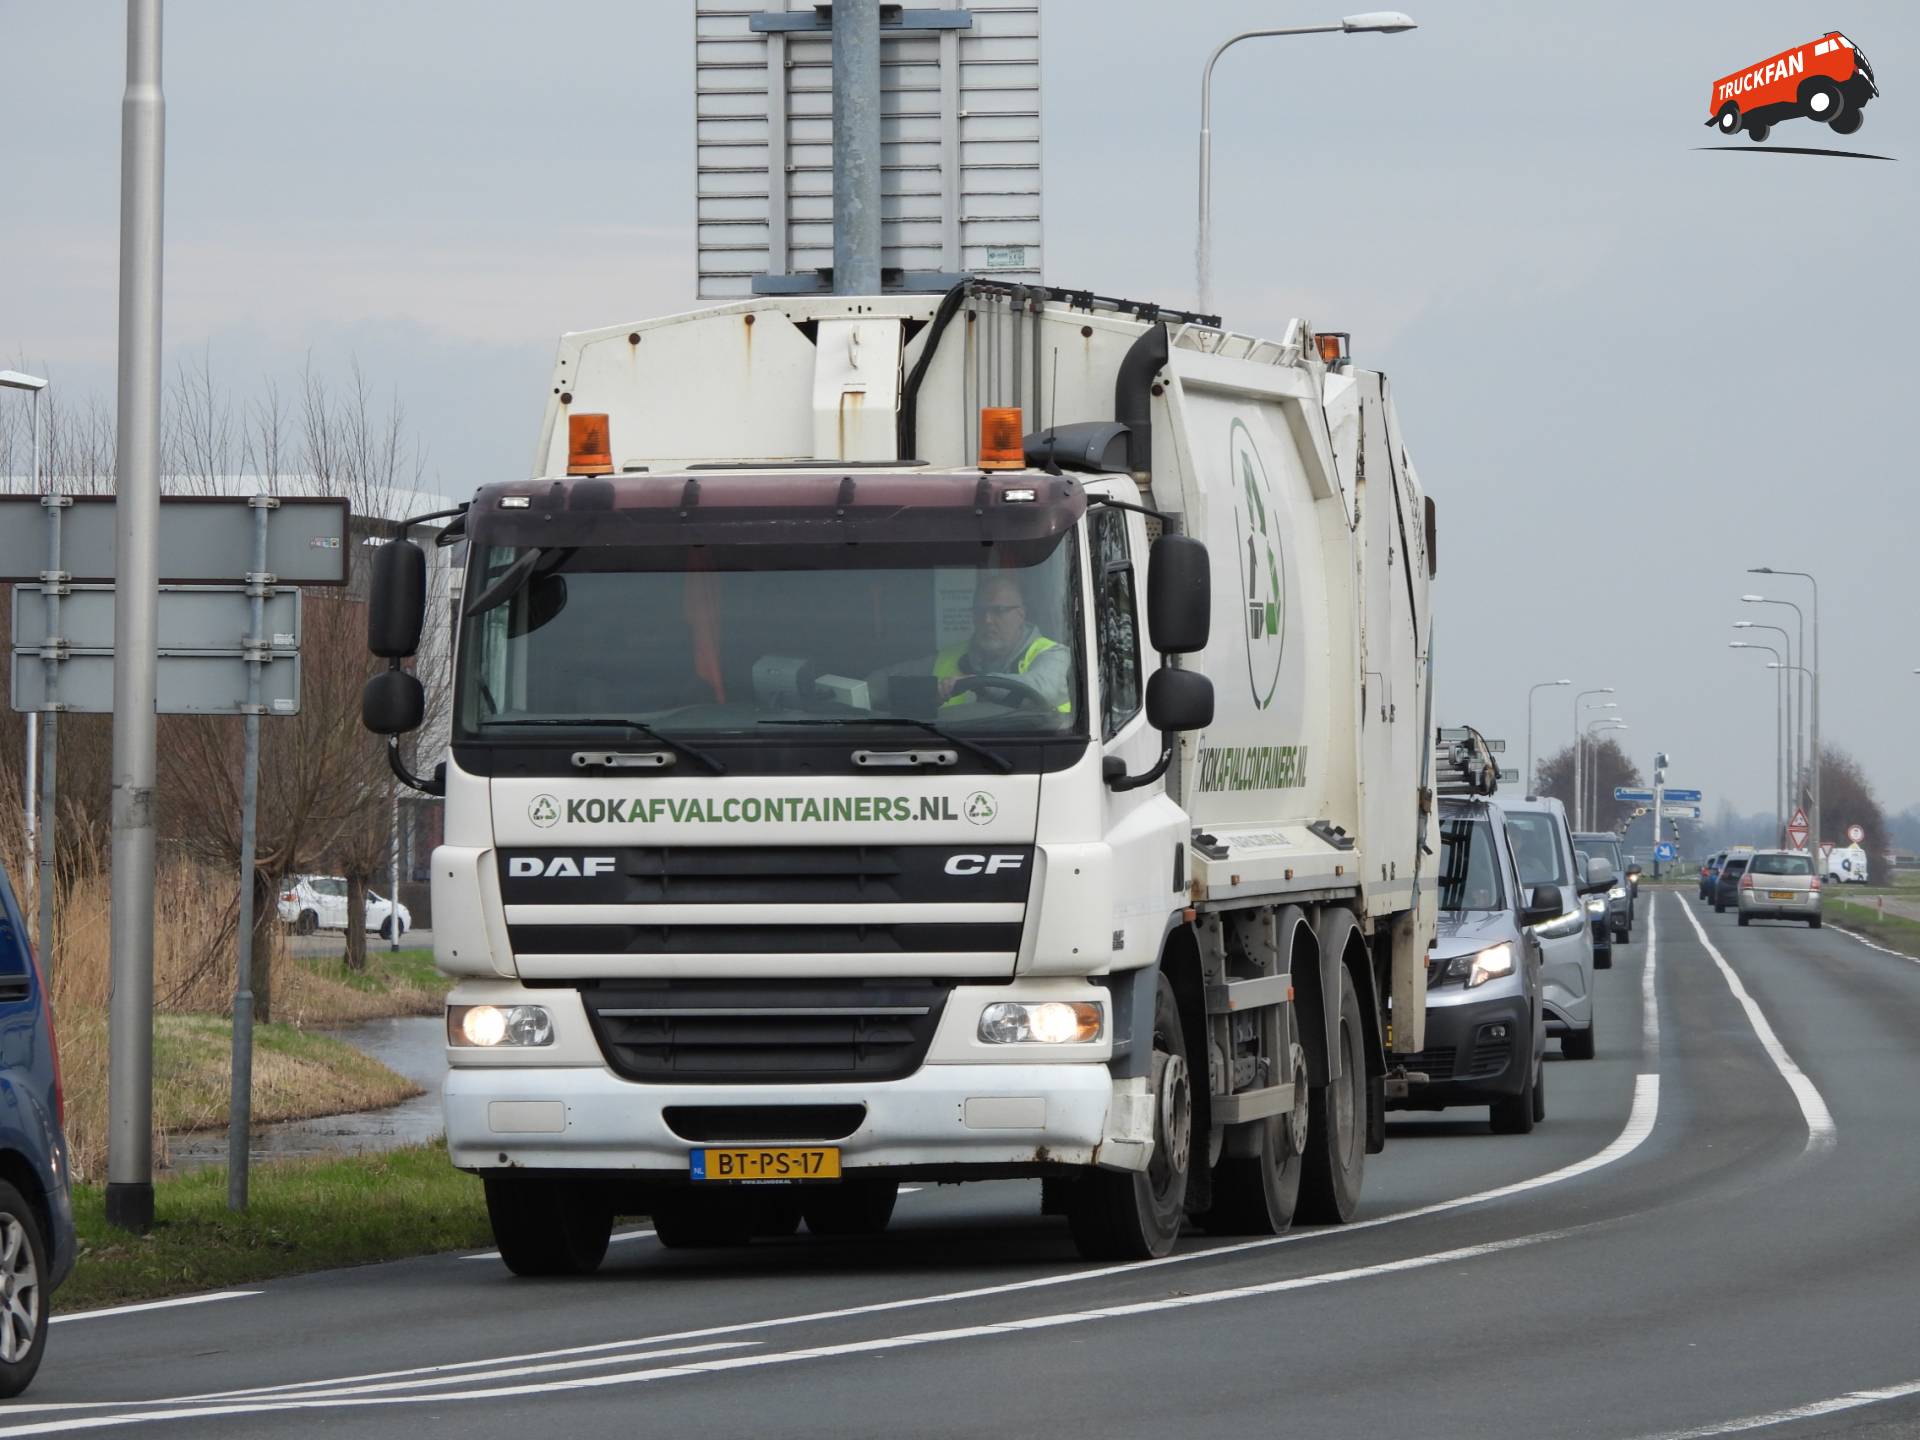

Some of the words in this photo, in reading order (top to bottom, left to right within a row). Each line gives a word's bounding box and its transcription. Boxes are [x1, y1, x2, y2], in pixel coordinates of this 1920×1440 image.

[1199, 745, 1308, 793] KOKAFVALCONTAINERS.NL
[566, 796, 959, 824] KOKAFVALCONTAINERS.NL
[508, 856, 616, 878] DAF
[943, 853, 1025, 876] CF
[693, 1167, 704, 1176] NL
[718, 1152, 825, 1176] BT-PS-17
